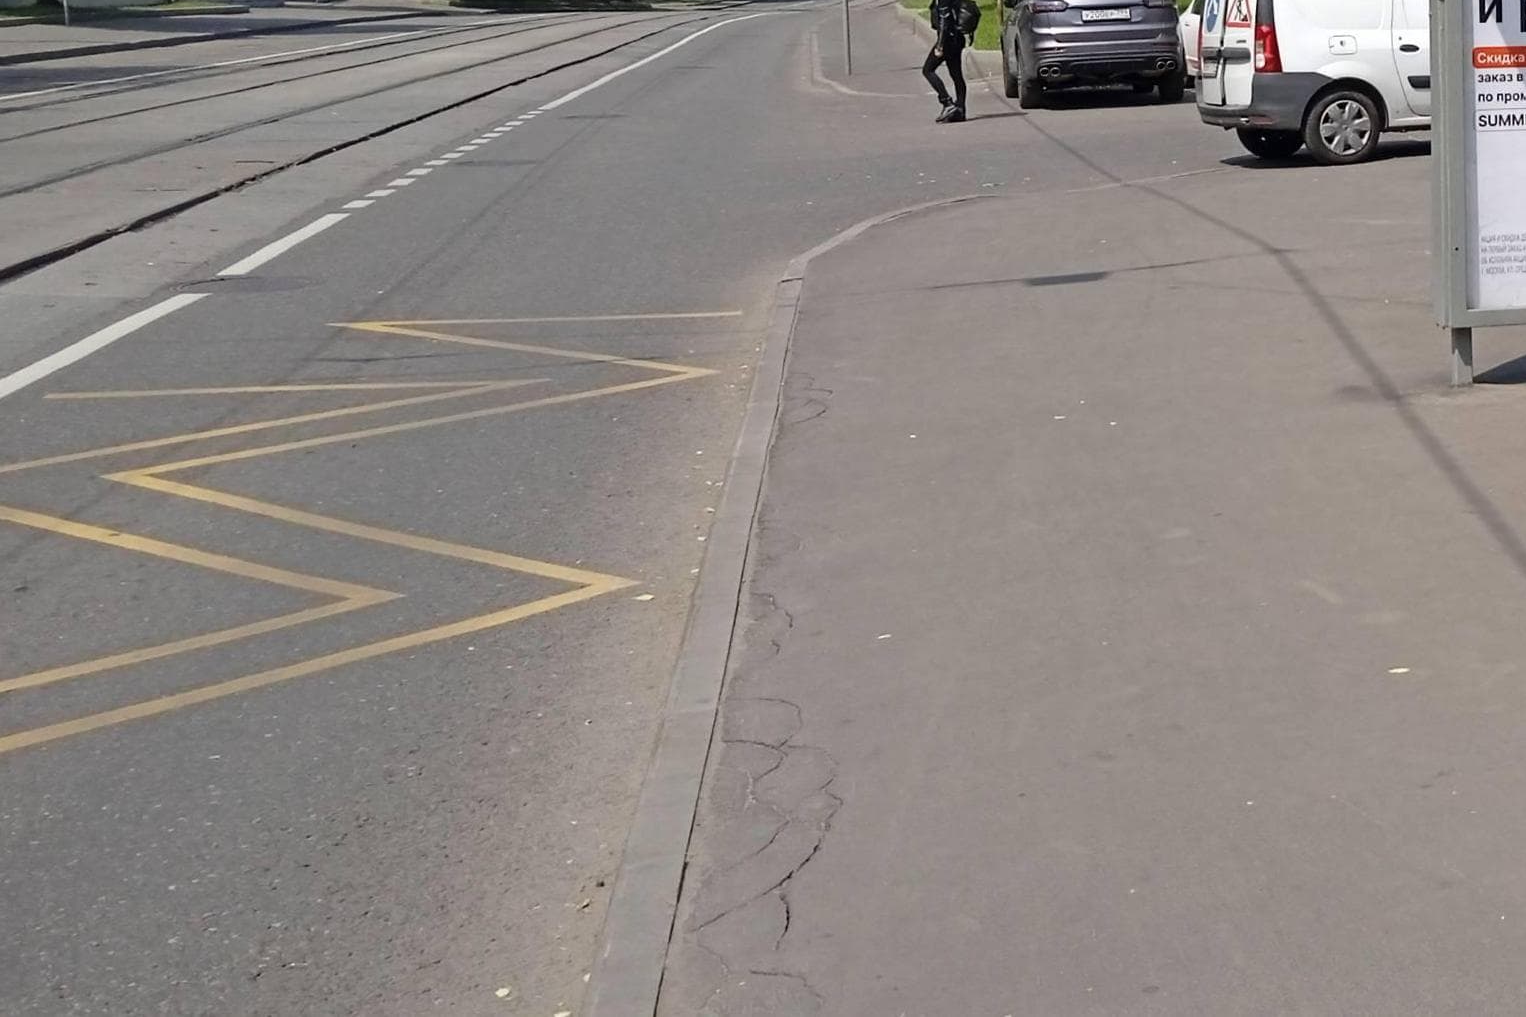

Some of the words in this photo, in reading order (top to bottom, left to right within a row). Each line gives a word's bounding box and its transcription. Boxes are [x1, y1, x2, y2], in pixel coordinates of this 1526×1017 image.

[1477, 52, 1525, 65] Скидка
[1477, 72, 1513, 83] заказ
[1516, 71, 1524, 82] в
[1478, 92, 1493, 102] по
